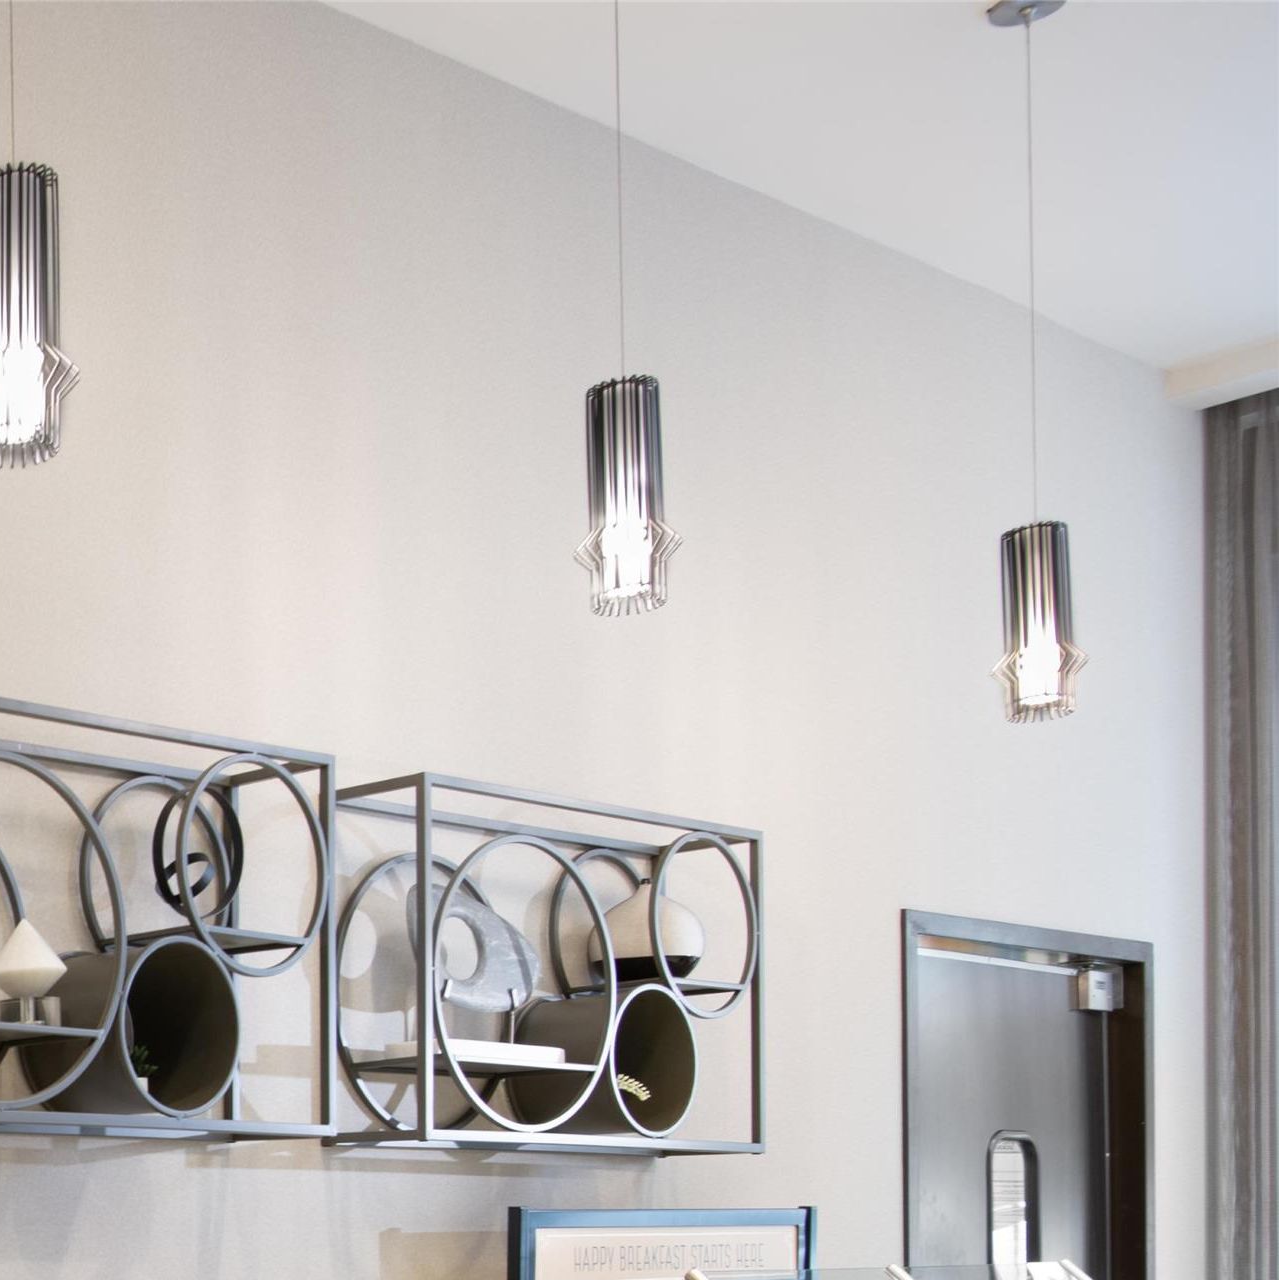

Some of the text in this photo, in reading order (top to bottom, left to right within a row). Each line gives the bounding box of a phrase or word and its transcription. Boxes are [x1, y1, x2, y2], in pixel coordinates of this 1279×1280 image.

[573, 1243, 765, 1273] HAPPY BREAKFAST STARTS HERE
